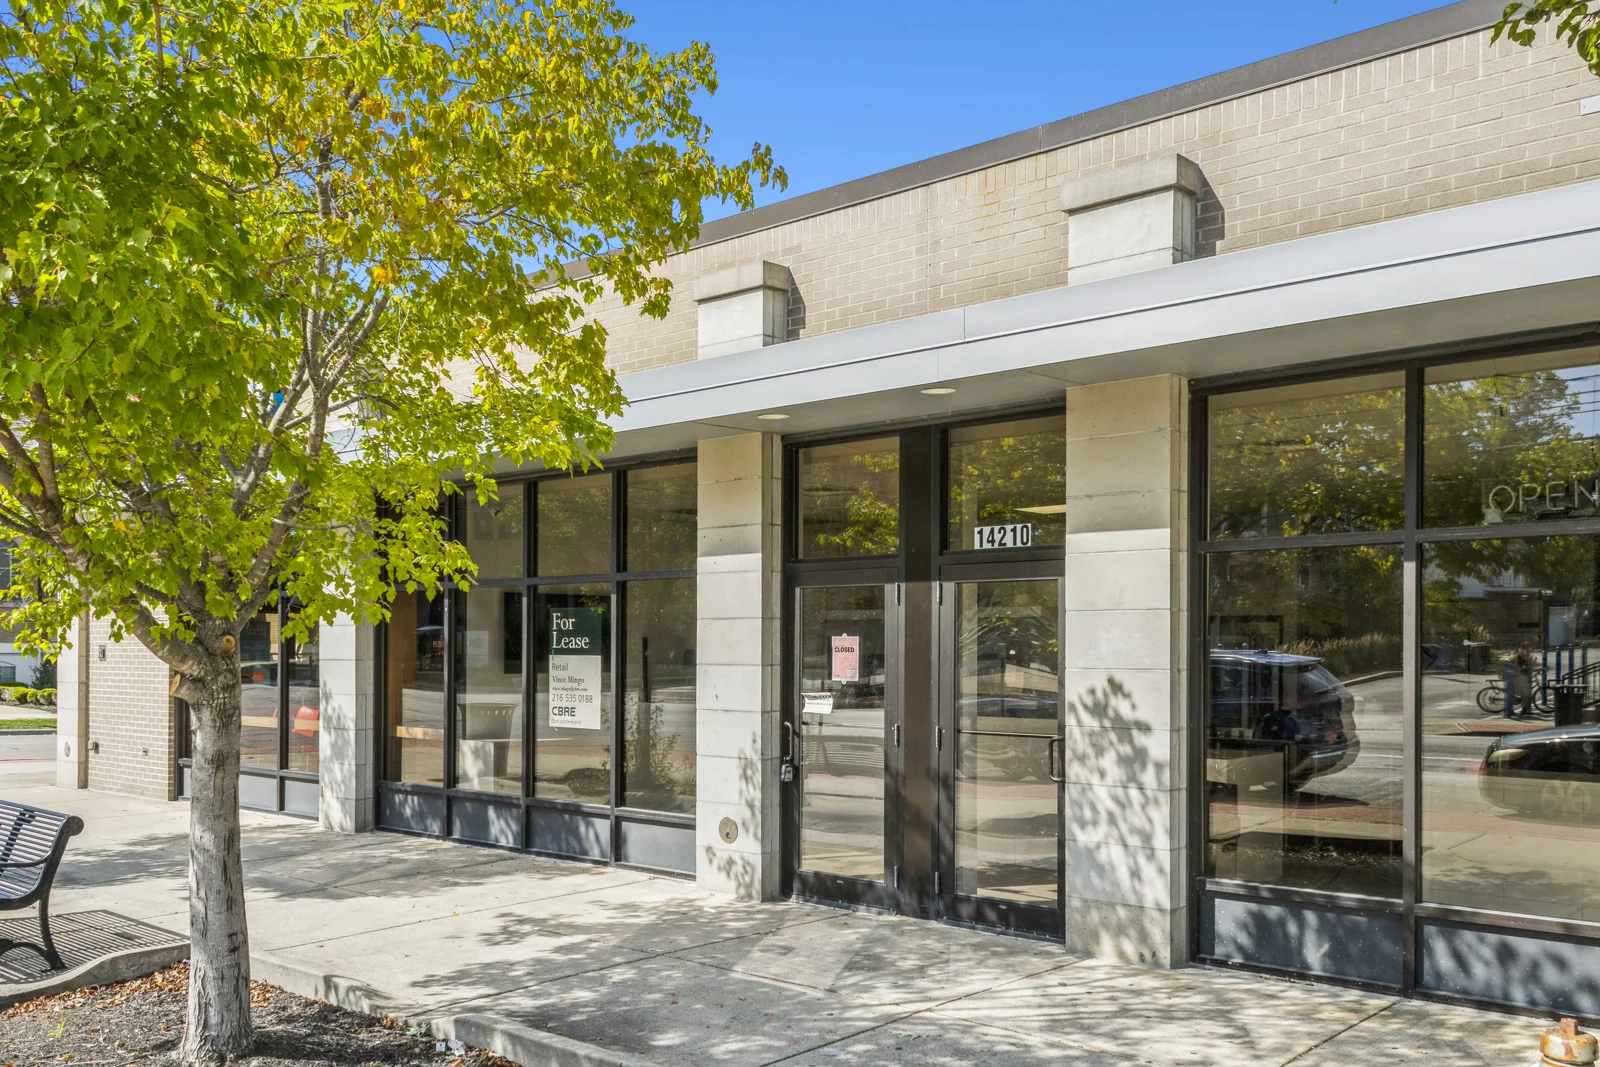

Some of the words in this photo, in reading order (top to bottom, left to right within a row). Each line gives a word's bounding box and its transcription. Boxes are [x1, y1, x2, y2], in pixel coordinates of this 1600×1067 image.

[1489, 480, 1599, 513] OPEN
[977, 524, 1029, 548] 14210
[552, 612, 575, 630] For
[552, 631, 589, 649] Lease
[551, 663, 569, 671] Retail
[567, 676, 584, 686] Mingo
[552, 694, 564, 702] 216
[565, 694, 577, 703] 535
[578, 695, 593, 703] 0188
[552, 706, 576, 717] CBRE
